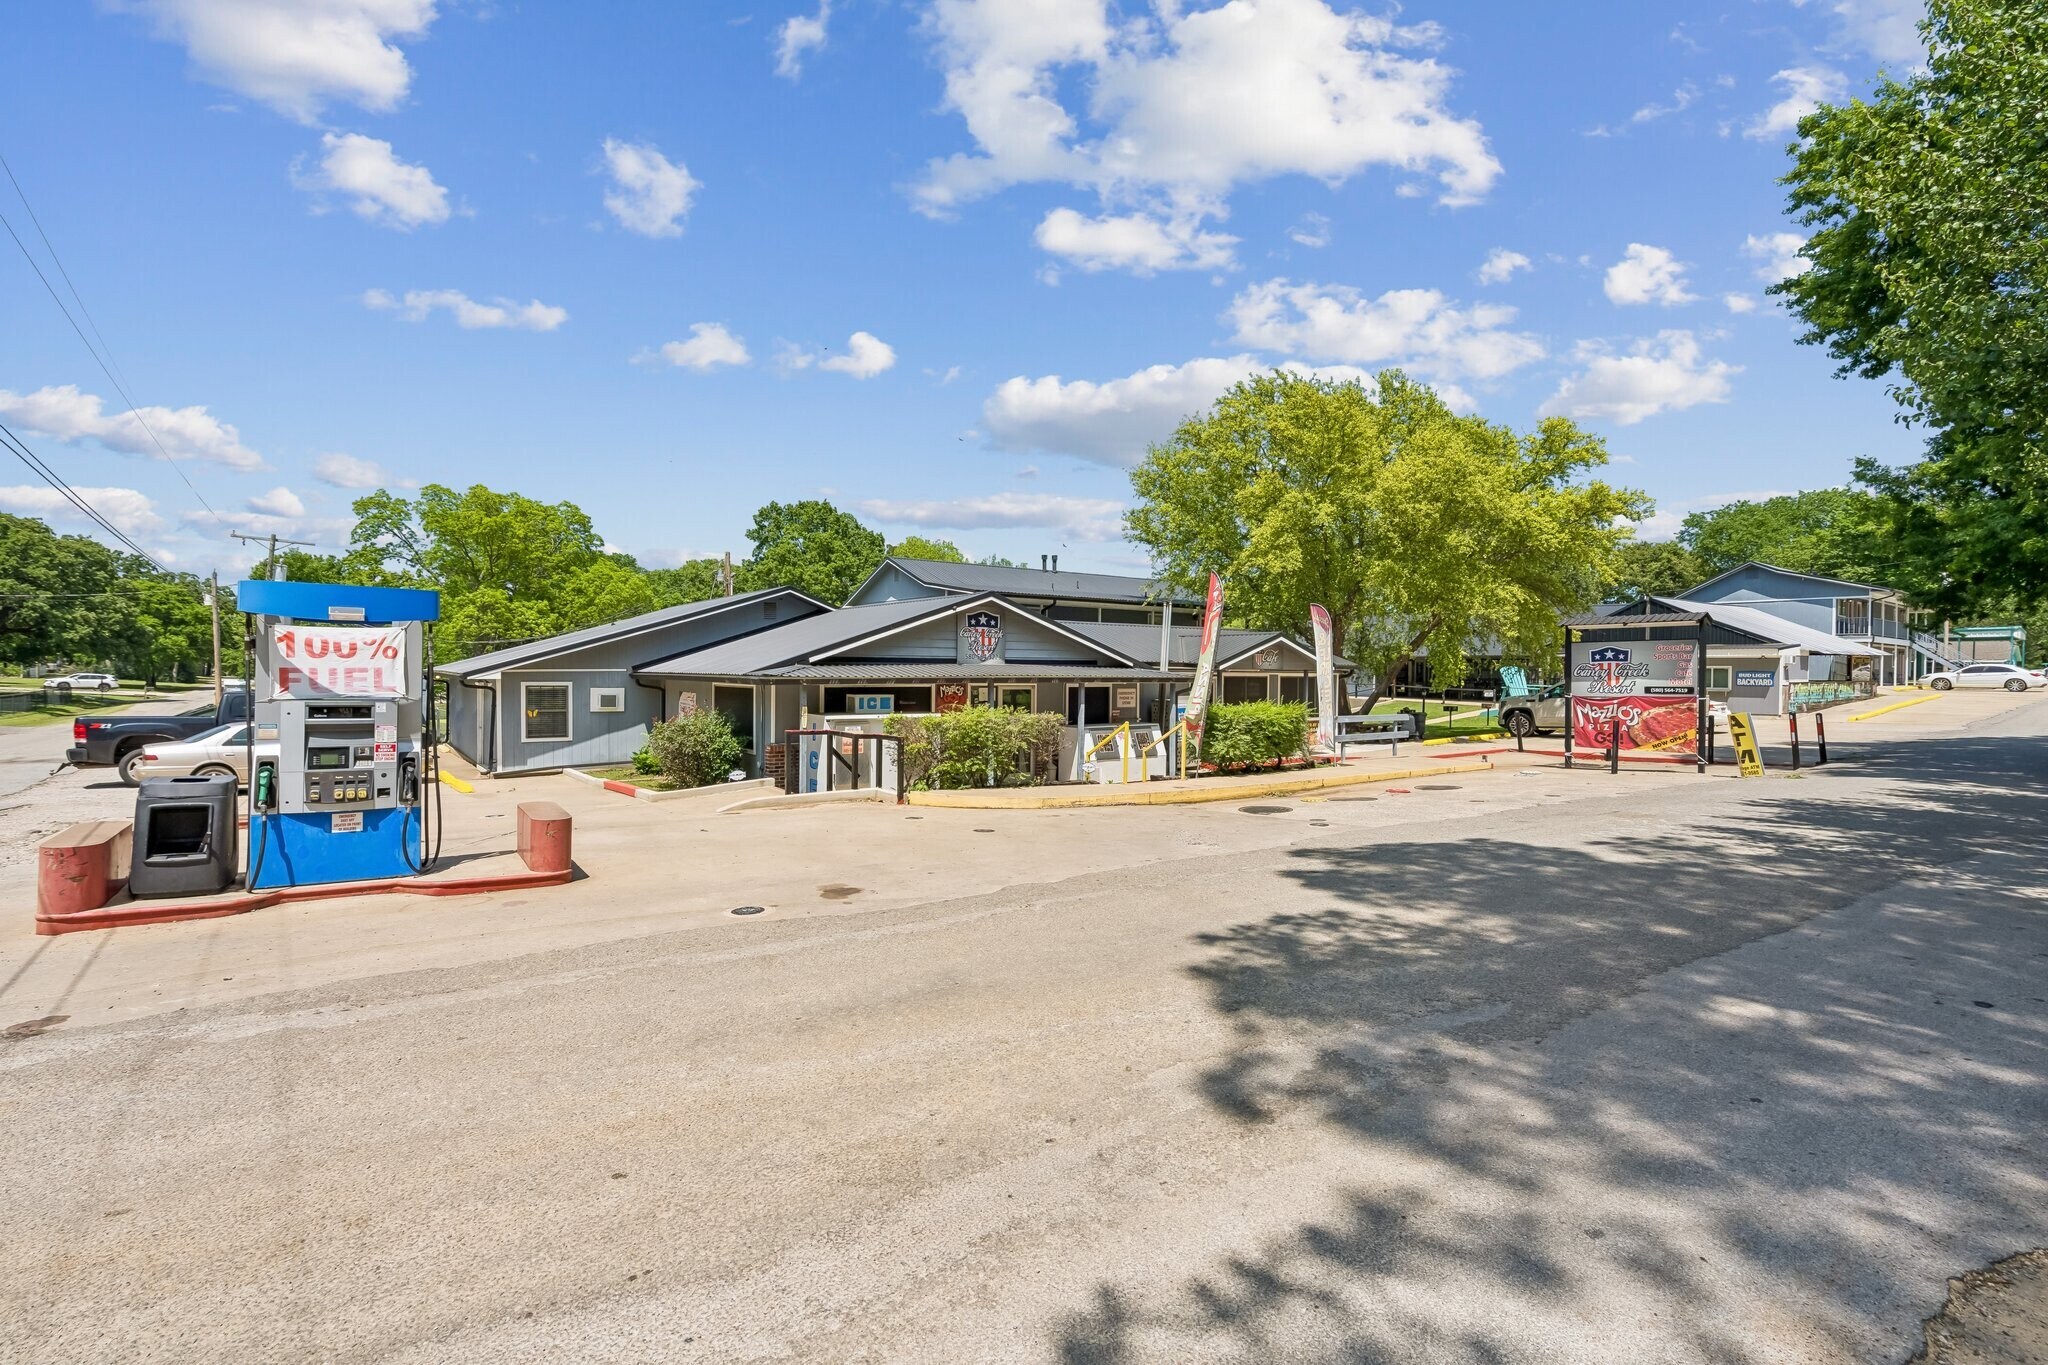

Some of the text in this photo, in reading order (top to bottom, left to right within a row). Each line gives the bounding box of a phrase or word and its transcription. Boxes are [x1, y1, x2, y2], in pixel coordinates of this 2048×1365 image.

[276, 630, 398, 659] 100%
[1656, 643, 1693, 651] Groceries
[1653, 652, 1692, 660] Sports Bar
[1573, 662, 1650, 680] Caney Creek
[1675, 669, 1693, 677] Cafe
[279, 667, 398, 693] FUEL
[1669, 677, 1692, 685] Motel
[1587, 680, 1636, 694] Resort
[858, 697, 891, 710] ICE
[1588, 723, 1629, 732] PIZA
[1652, 739, 1668, 750] NOW
